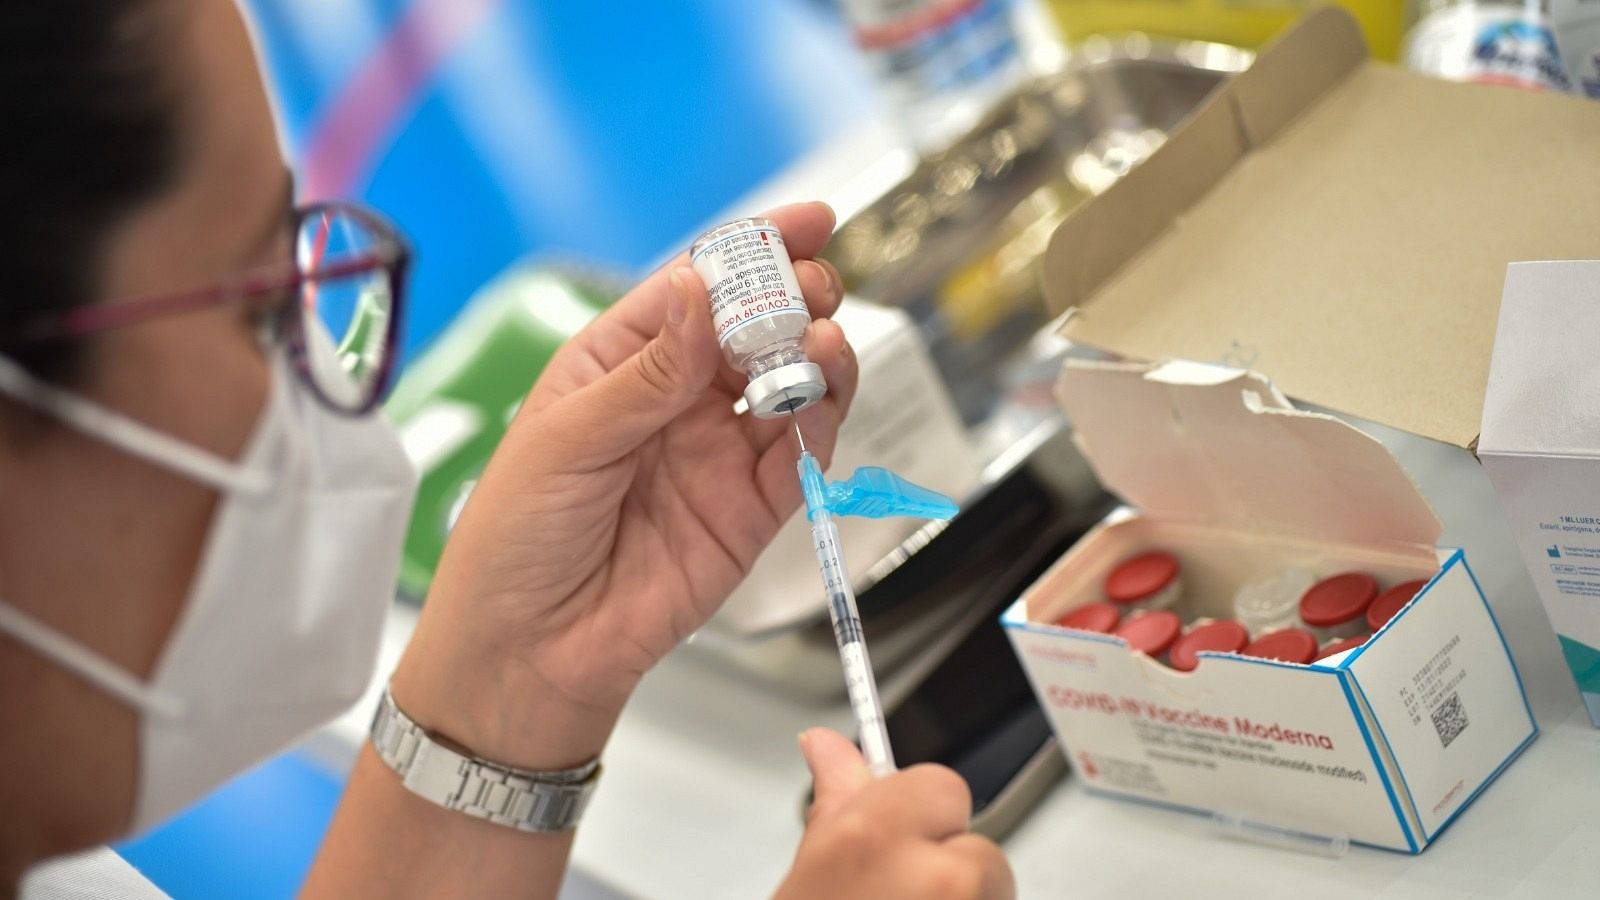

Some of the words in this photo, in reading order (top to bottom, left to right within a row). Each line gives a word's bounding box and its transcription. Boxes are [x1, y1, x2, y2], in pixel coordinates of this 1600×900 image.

[726, 262, 738, 271] Use
[735, 262, 778, 280] (nucleoside
[745, 272, 782, 288] COVID-19
[722, 282, 744, 299] mRNA
[740, 290, 787, 306] Moderna
[744, 299, 790, 318] COVID-19
[1576, 517, 1594, 525] LUER
[819, 538, 834, 550] 0.1
[824, 557, 838, 568] 0.2
[828, 576, 843, 588] 0.3
[1142, 701, 1229, 733] Vaccine
[1234, 717, 1335, 751] Moderna
